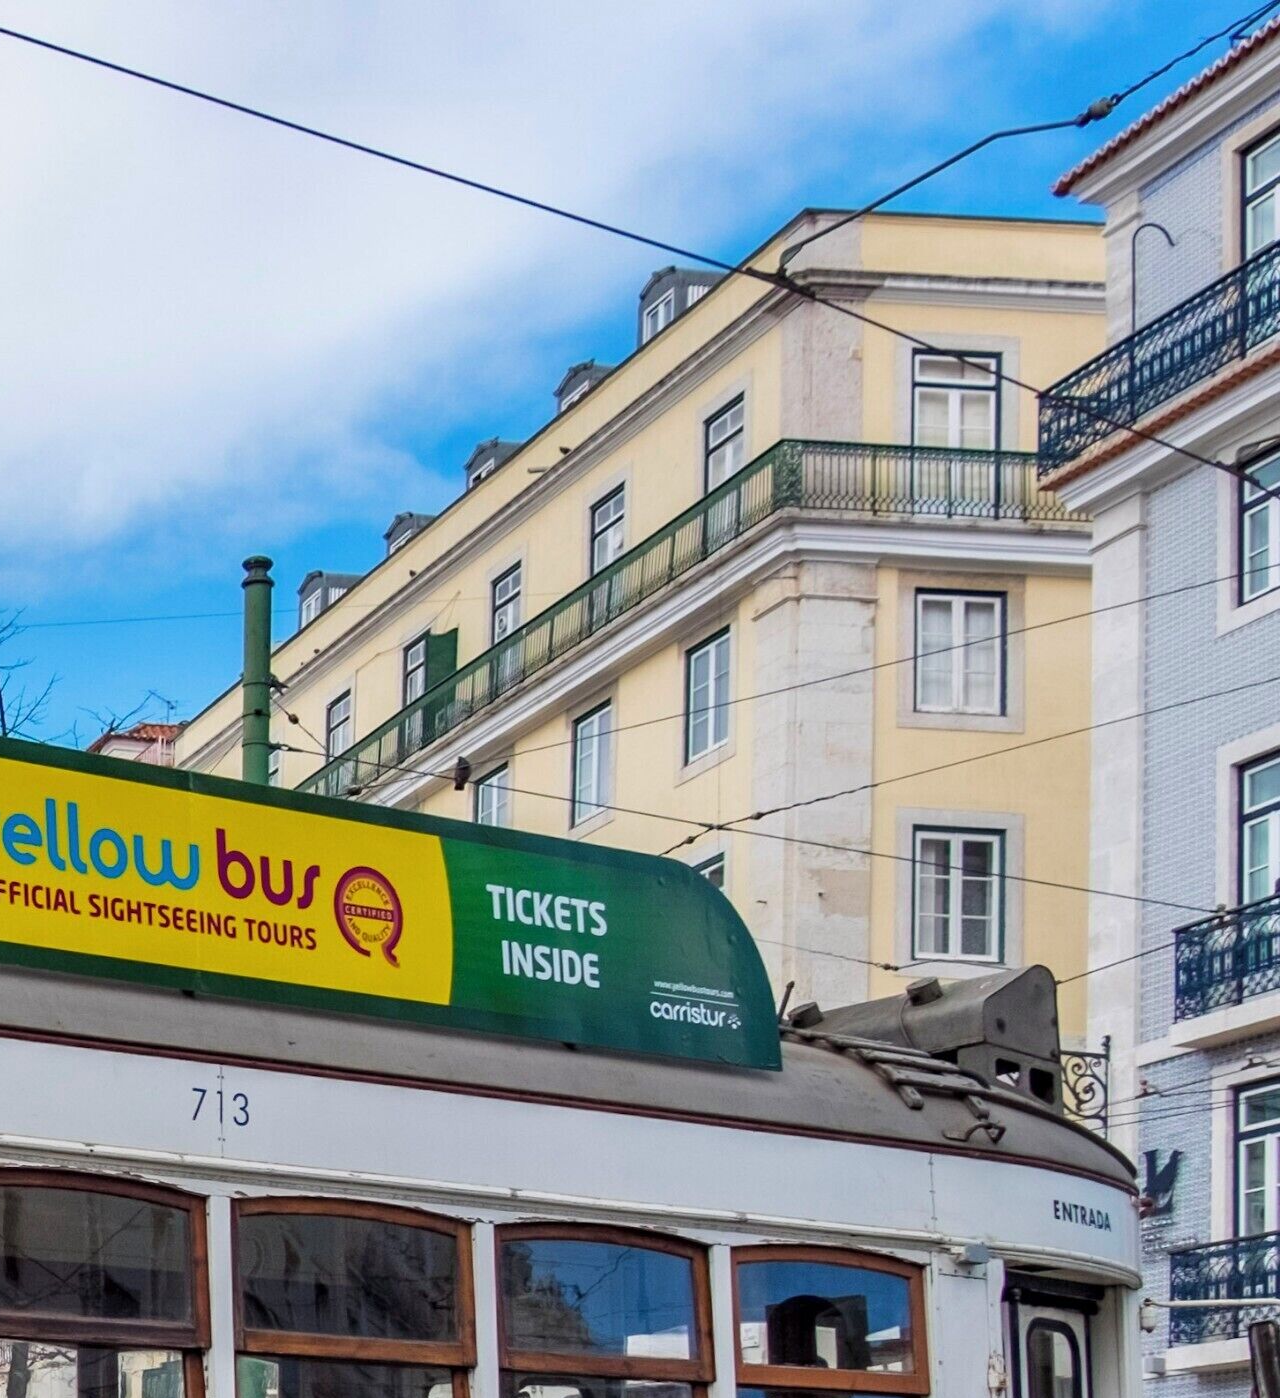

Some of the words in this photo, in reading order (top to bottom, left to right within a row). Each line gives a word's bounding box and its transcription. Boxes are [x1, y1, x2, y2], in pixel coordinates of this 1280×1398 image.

[216, 828, 320, 909] bus
[346, 880, 389, 905] EXCELLENCE
[486, 884, 608, 936] TICKETS
[89, 894, 237, 938] SIGHTSEEING
[244, 919, 317, 951] TOURS
[344, 905, 393, 920] CERTIFIED
[501, 940, 600, 988] INSIDE
[650, 1001, 726, 1027] carristur
[192, 1088, 250, 1126] 713
[1053, 1200, 1112, 1232] ENTRADA
